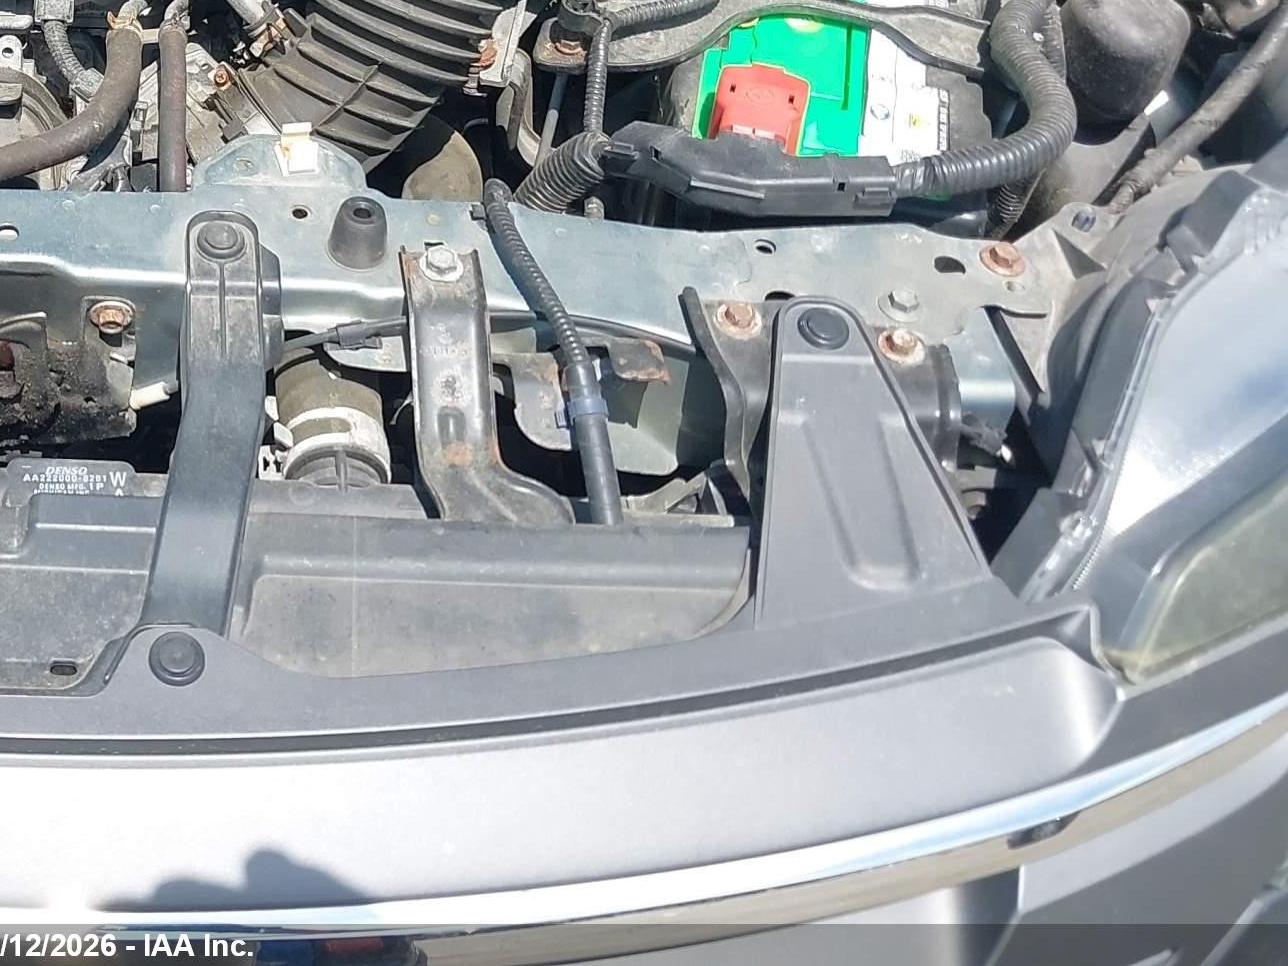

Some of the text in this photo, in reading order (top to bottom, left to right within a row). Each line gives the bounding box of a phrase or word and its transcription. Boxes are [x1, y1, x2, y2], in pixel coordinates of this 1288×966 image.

[45, 466, 88, 475] DENSO
[109, 471, 127, 487] W
[39, 482, 65, 490] DENSO
